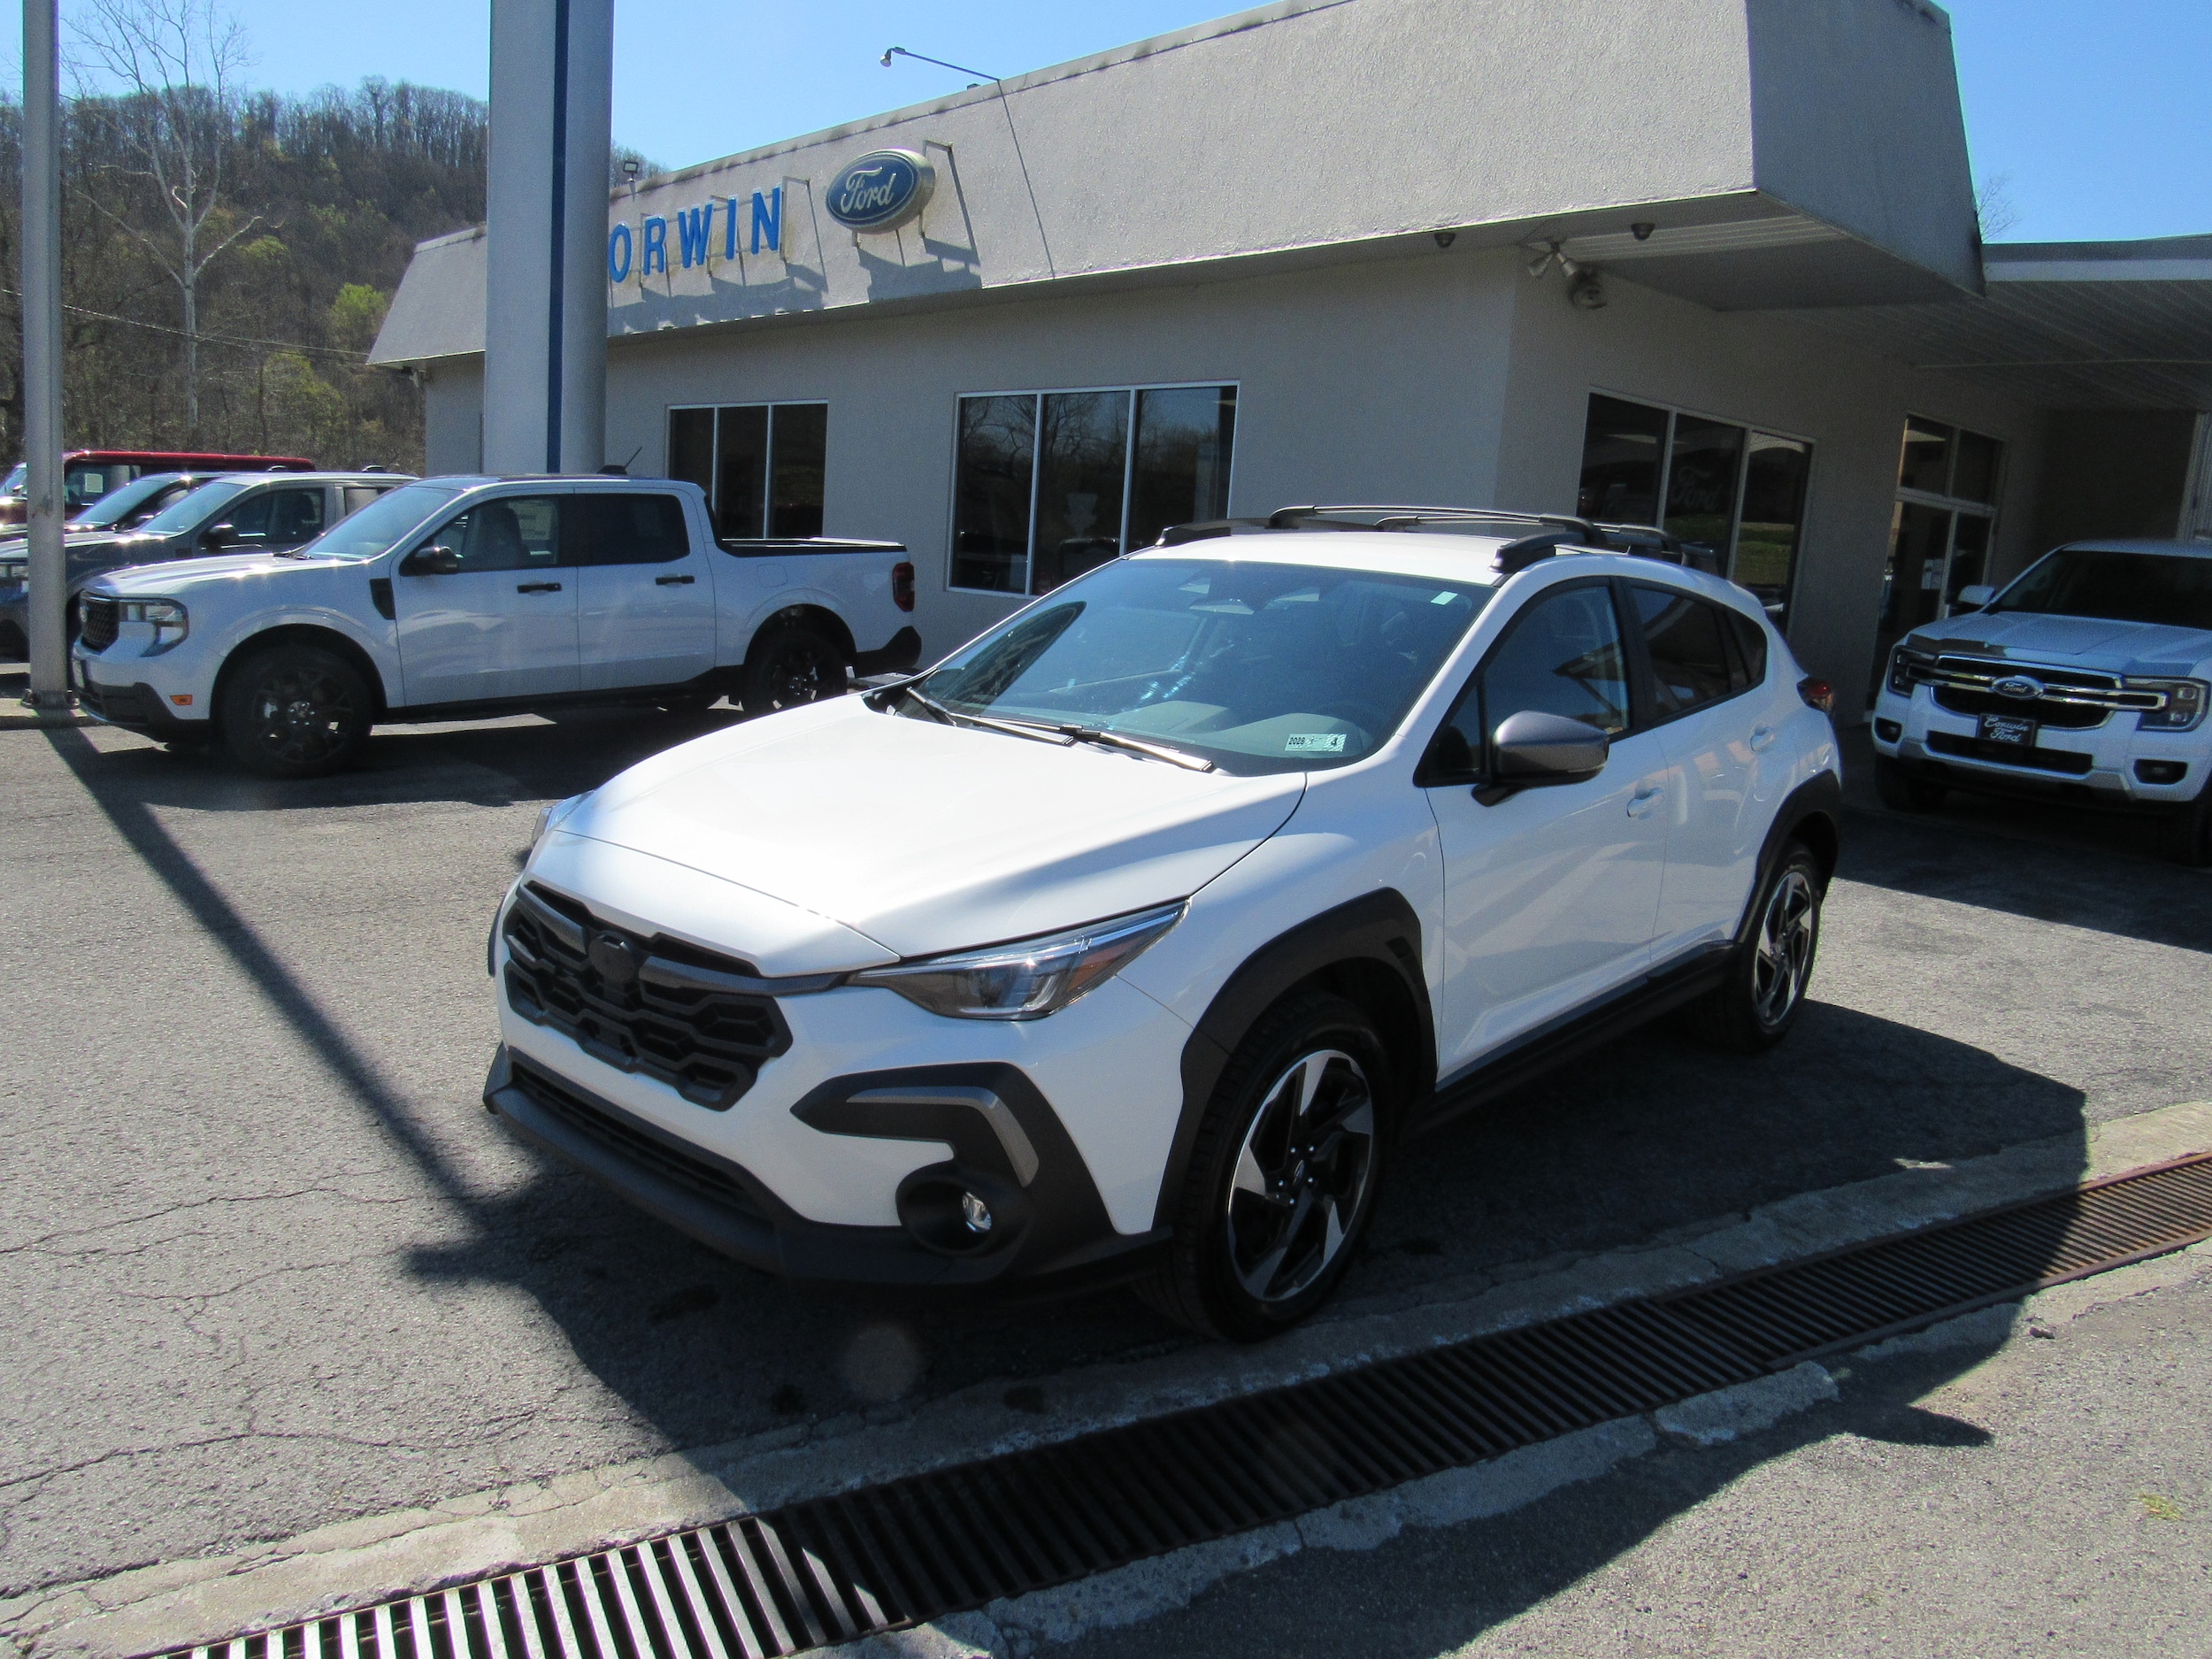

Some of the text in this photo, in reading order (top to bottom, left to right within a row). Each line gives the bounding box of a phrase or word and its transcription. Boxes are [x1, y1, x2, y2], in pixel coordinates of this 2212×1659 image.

[841, 166, 897, 213] Ford
[2003, 681, 2028, 694] Ford
[1989, 727, 2022, 742] Ford
